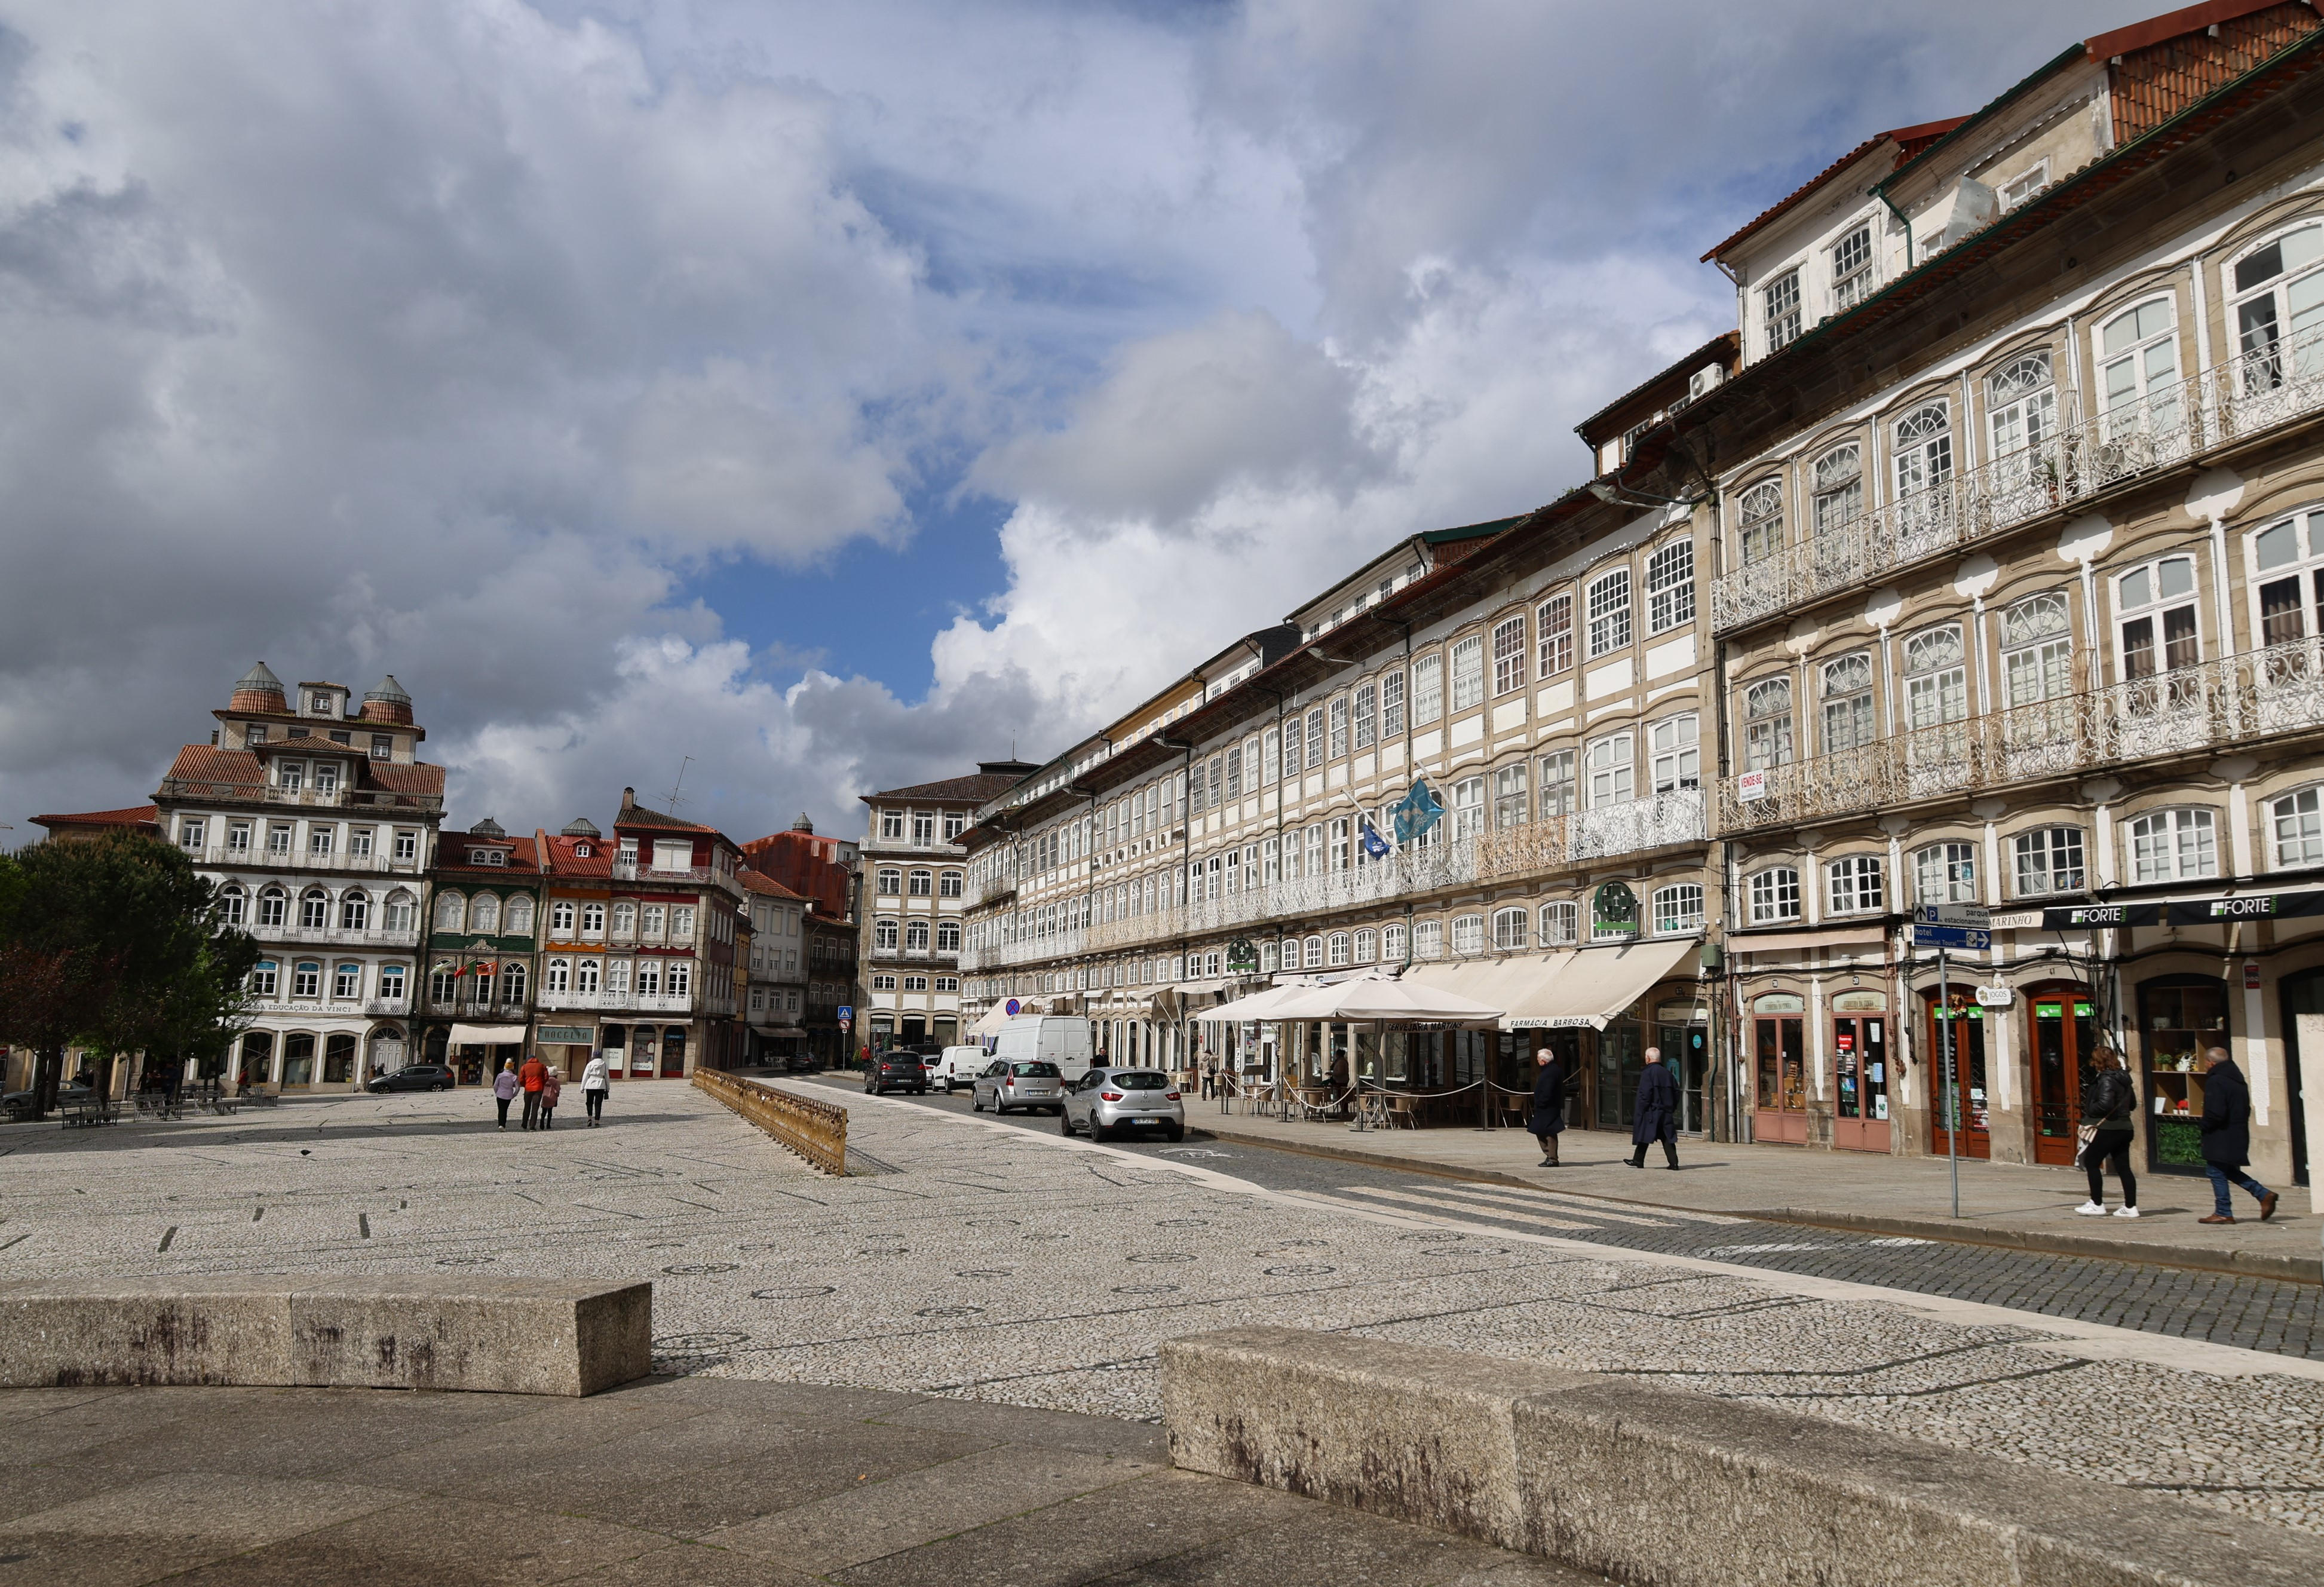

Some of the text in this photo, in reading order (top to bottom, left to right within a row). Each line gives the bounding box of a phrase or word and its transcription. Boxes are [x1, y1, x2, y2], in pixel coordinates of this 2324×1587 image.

[1741, 773, 1762, 788] VENDE-SE
[2224, 898, 2270, 915] FORTE
[1930, 910, 1936, 920] P
[2083, 908, 2121, 923] FORTE
[1944, 917, 1989, 926] estacionamento
[1915, 928, 1933, 936] hotel
[1989, 991, 2007, 999] JOGOS
[269, 1004, 309, 1012] EDUCAÇÃO
[1388, 1022, 1464, 1031] CERVEJARIA MARTINS
[1510, 1018, 1590, 1027] FARMÁCIA BARBOSA
